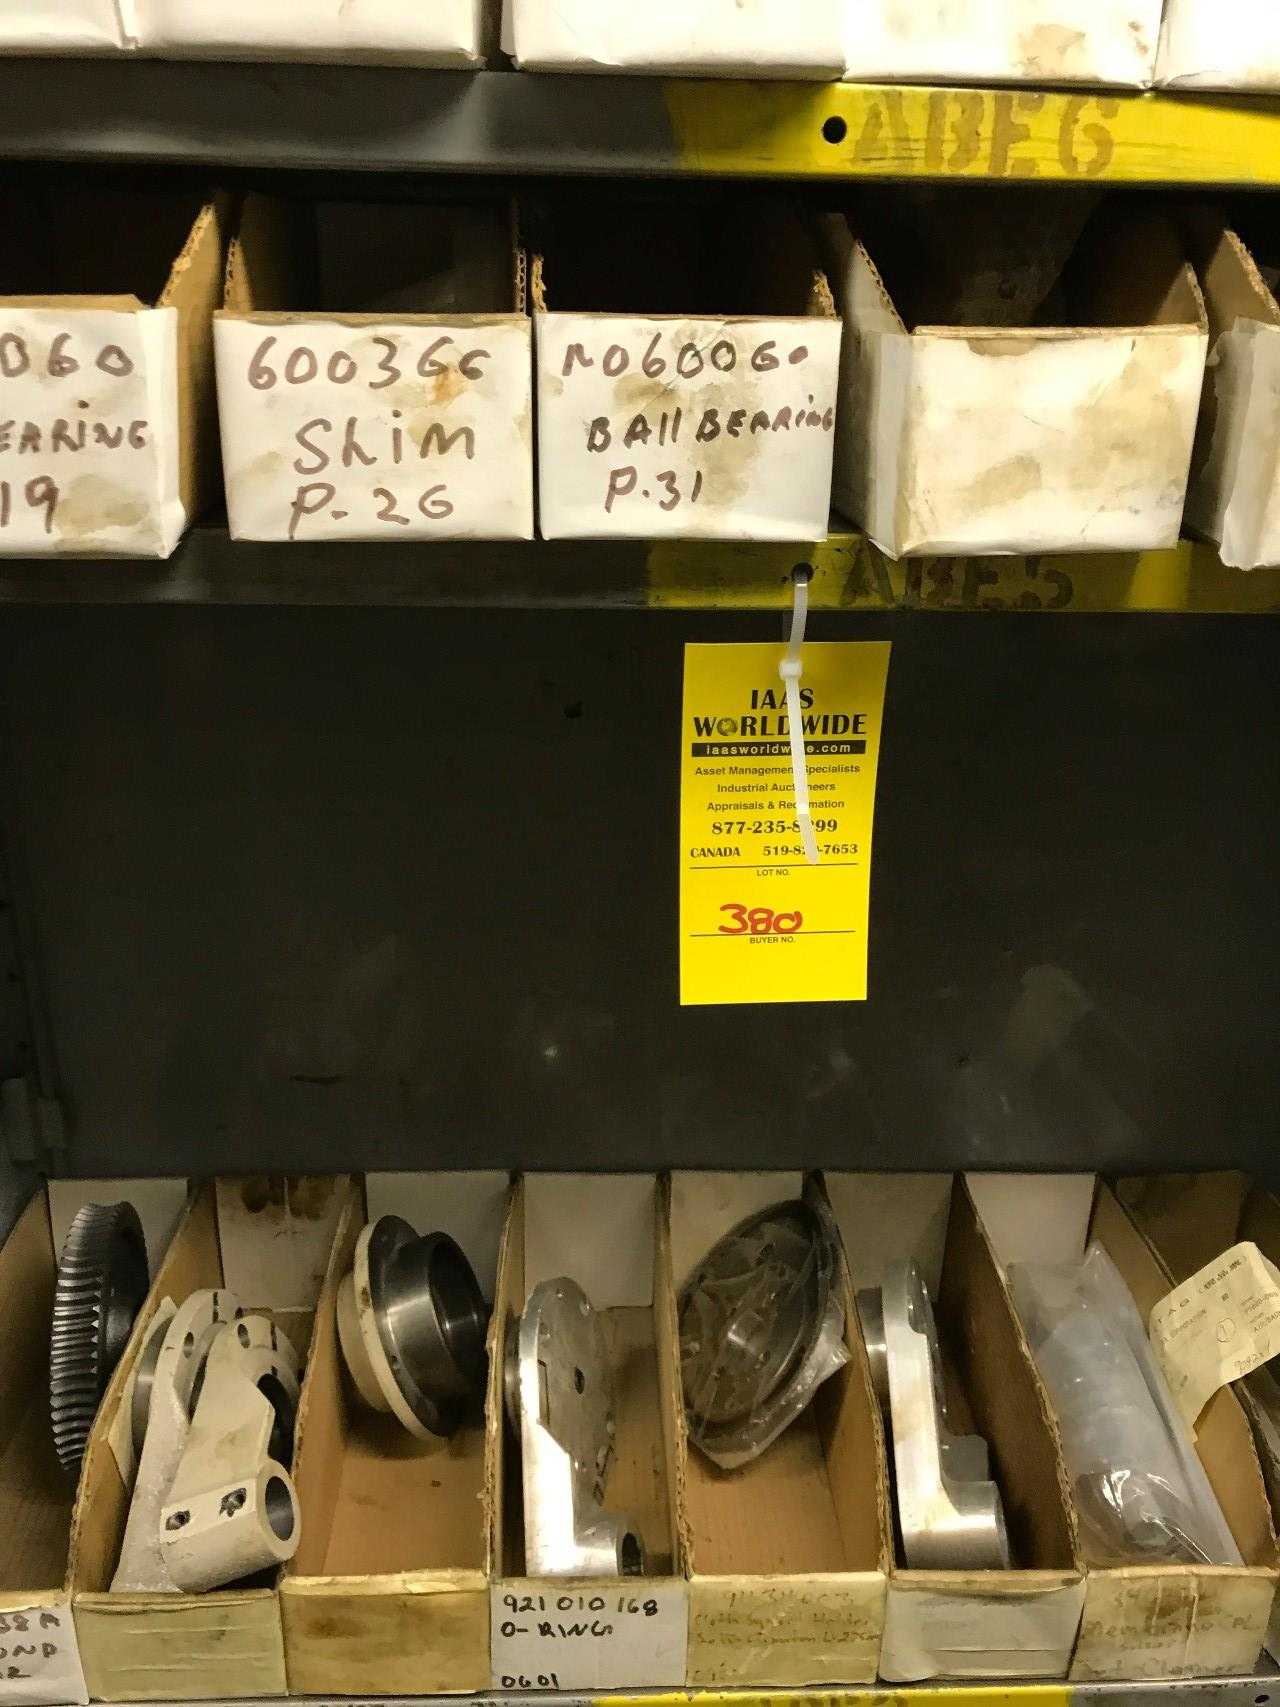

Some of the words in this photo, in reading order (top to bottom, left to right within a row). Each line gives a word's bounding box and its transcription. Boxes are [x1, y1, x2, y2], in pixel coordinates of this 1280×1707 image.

[706, 743, 851, 755] iaasworldwe.com
[695, 766, 725, 776] Asset
[729, 765, 796, 777] Managemen
[717, 784, 768, 793] Industrial
[771, 783, 836, 793] Auctneers
[707, 801, 764, 812] Appraisals
[767, 802, 775, 810] &
[778, 800, 845, 810] Recmation
[711, 819, 838, 834] 877-235-899
[690, 846, 741, 858] CANADA
[763, 844, 858, 857] 519-8-7653
[756, 869, 774, 877] LOT
[718, 903, 803, 935] 380
[749, 936, 778, 944] BUYER
